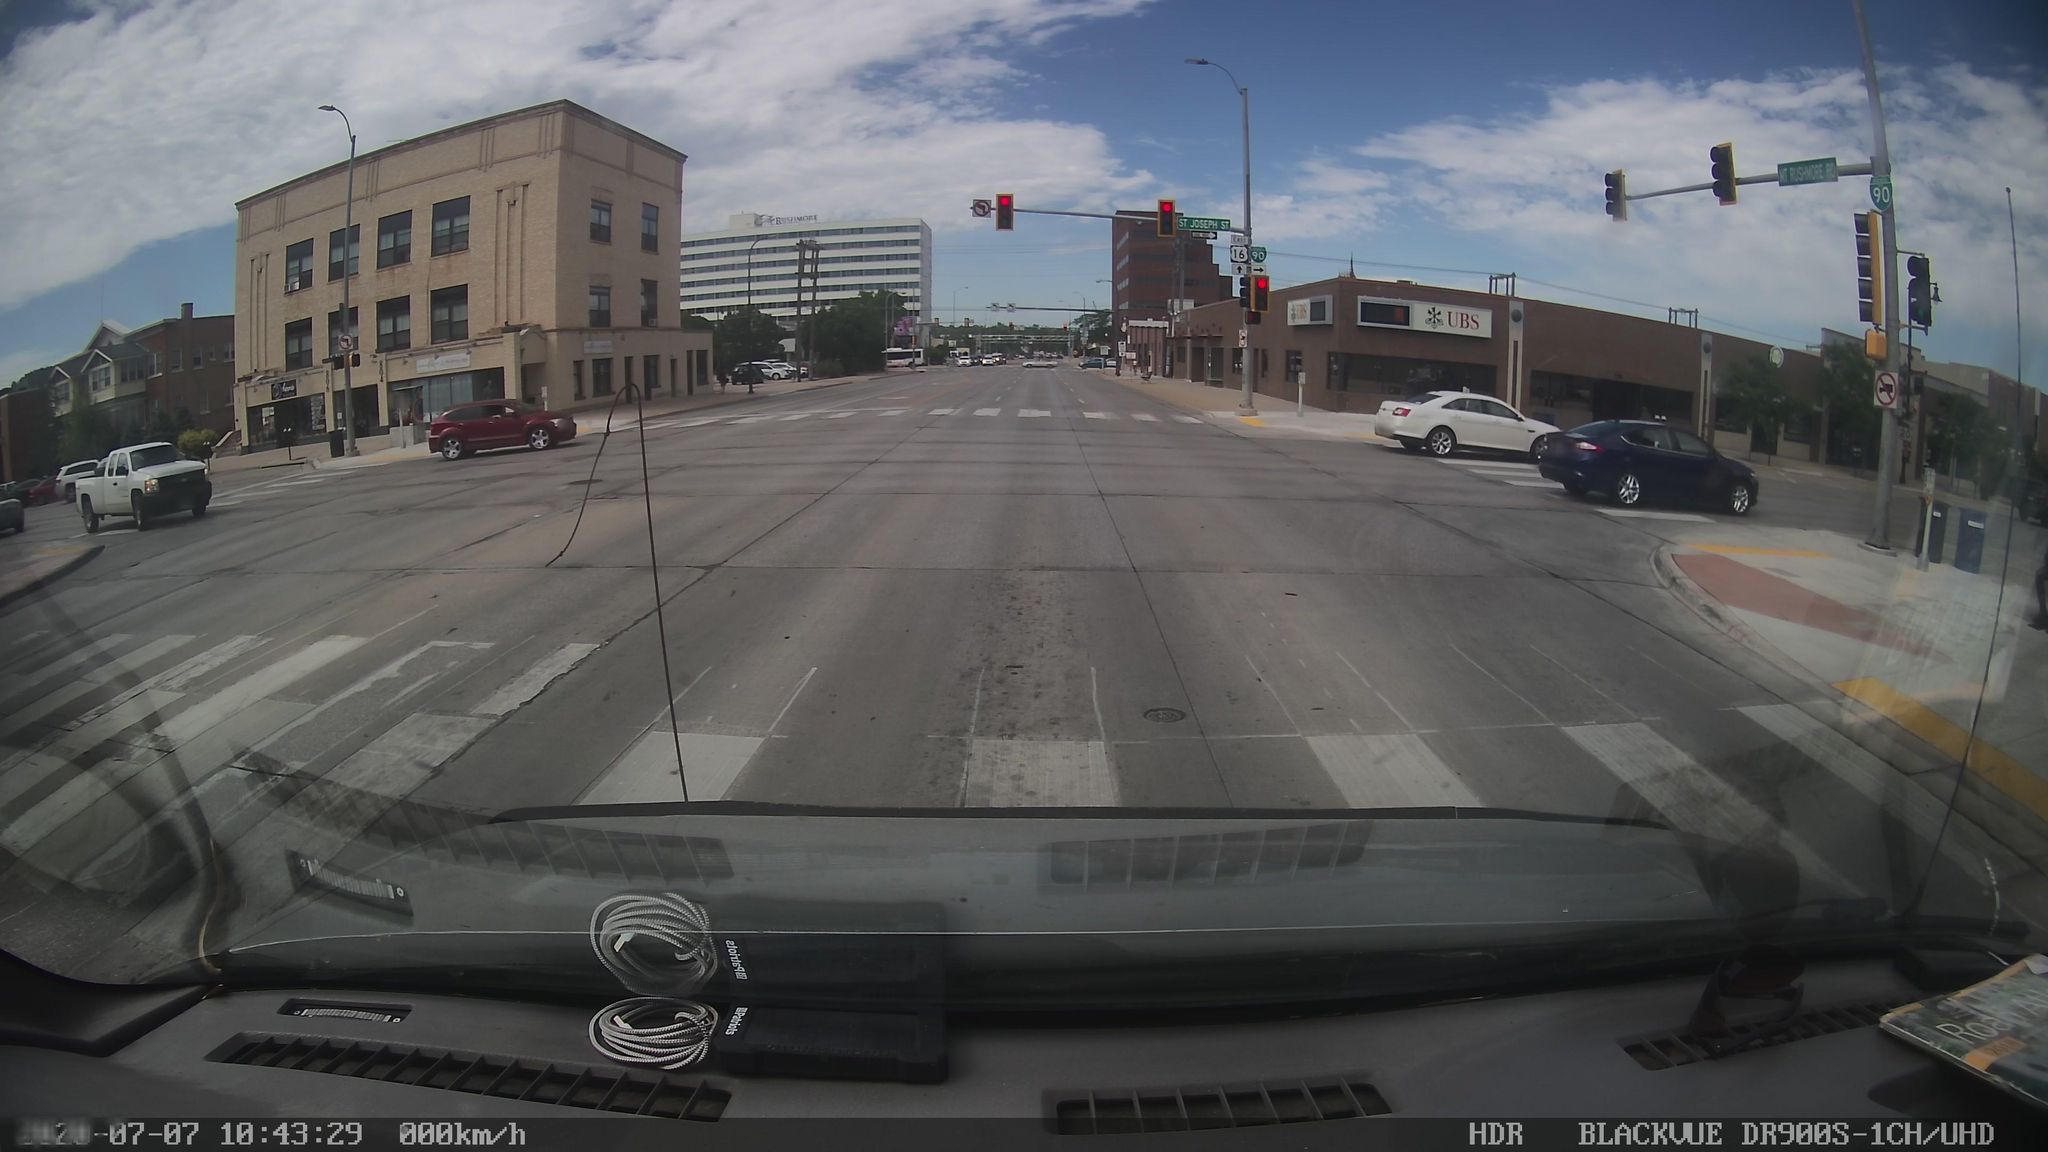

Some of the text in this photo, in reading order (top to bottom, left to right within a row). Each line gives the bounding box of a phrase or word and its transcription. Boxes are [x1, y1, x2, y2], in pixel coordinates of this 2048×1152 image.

[1873, 186, 1890, 203] 90
[1178, 218, 1230, 230] ST JOSEPH ST
[1233, 248, 1245, 259] 16
[1252, 251, 1264, 260] 90
[1447, 311, 1480, 330] UBS
